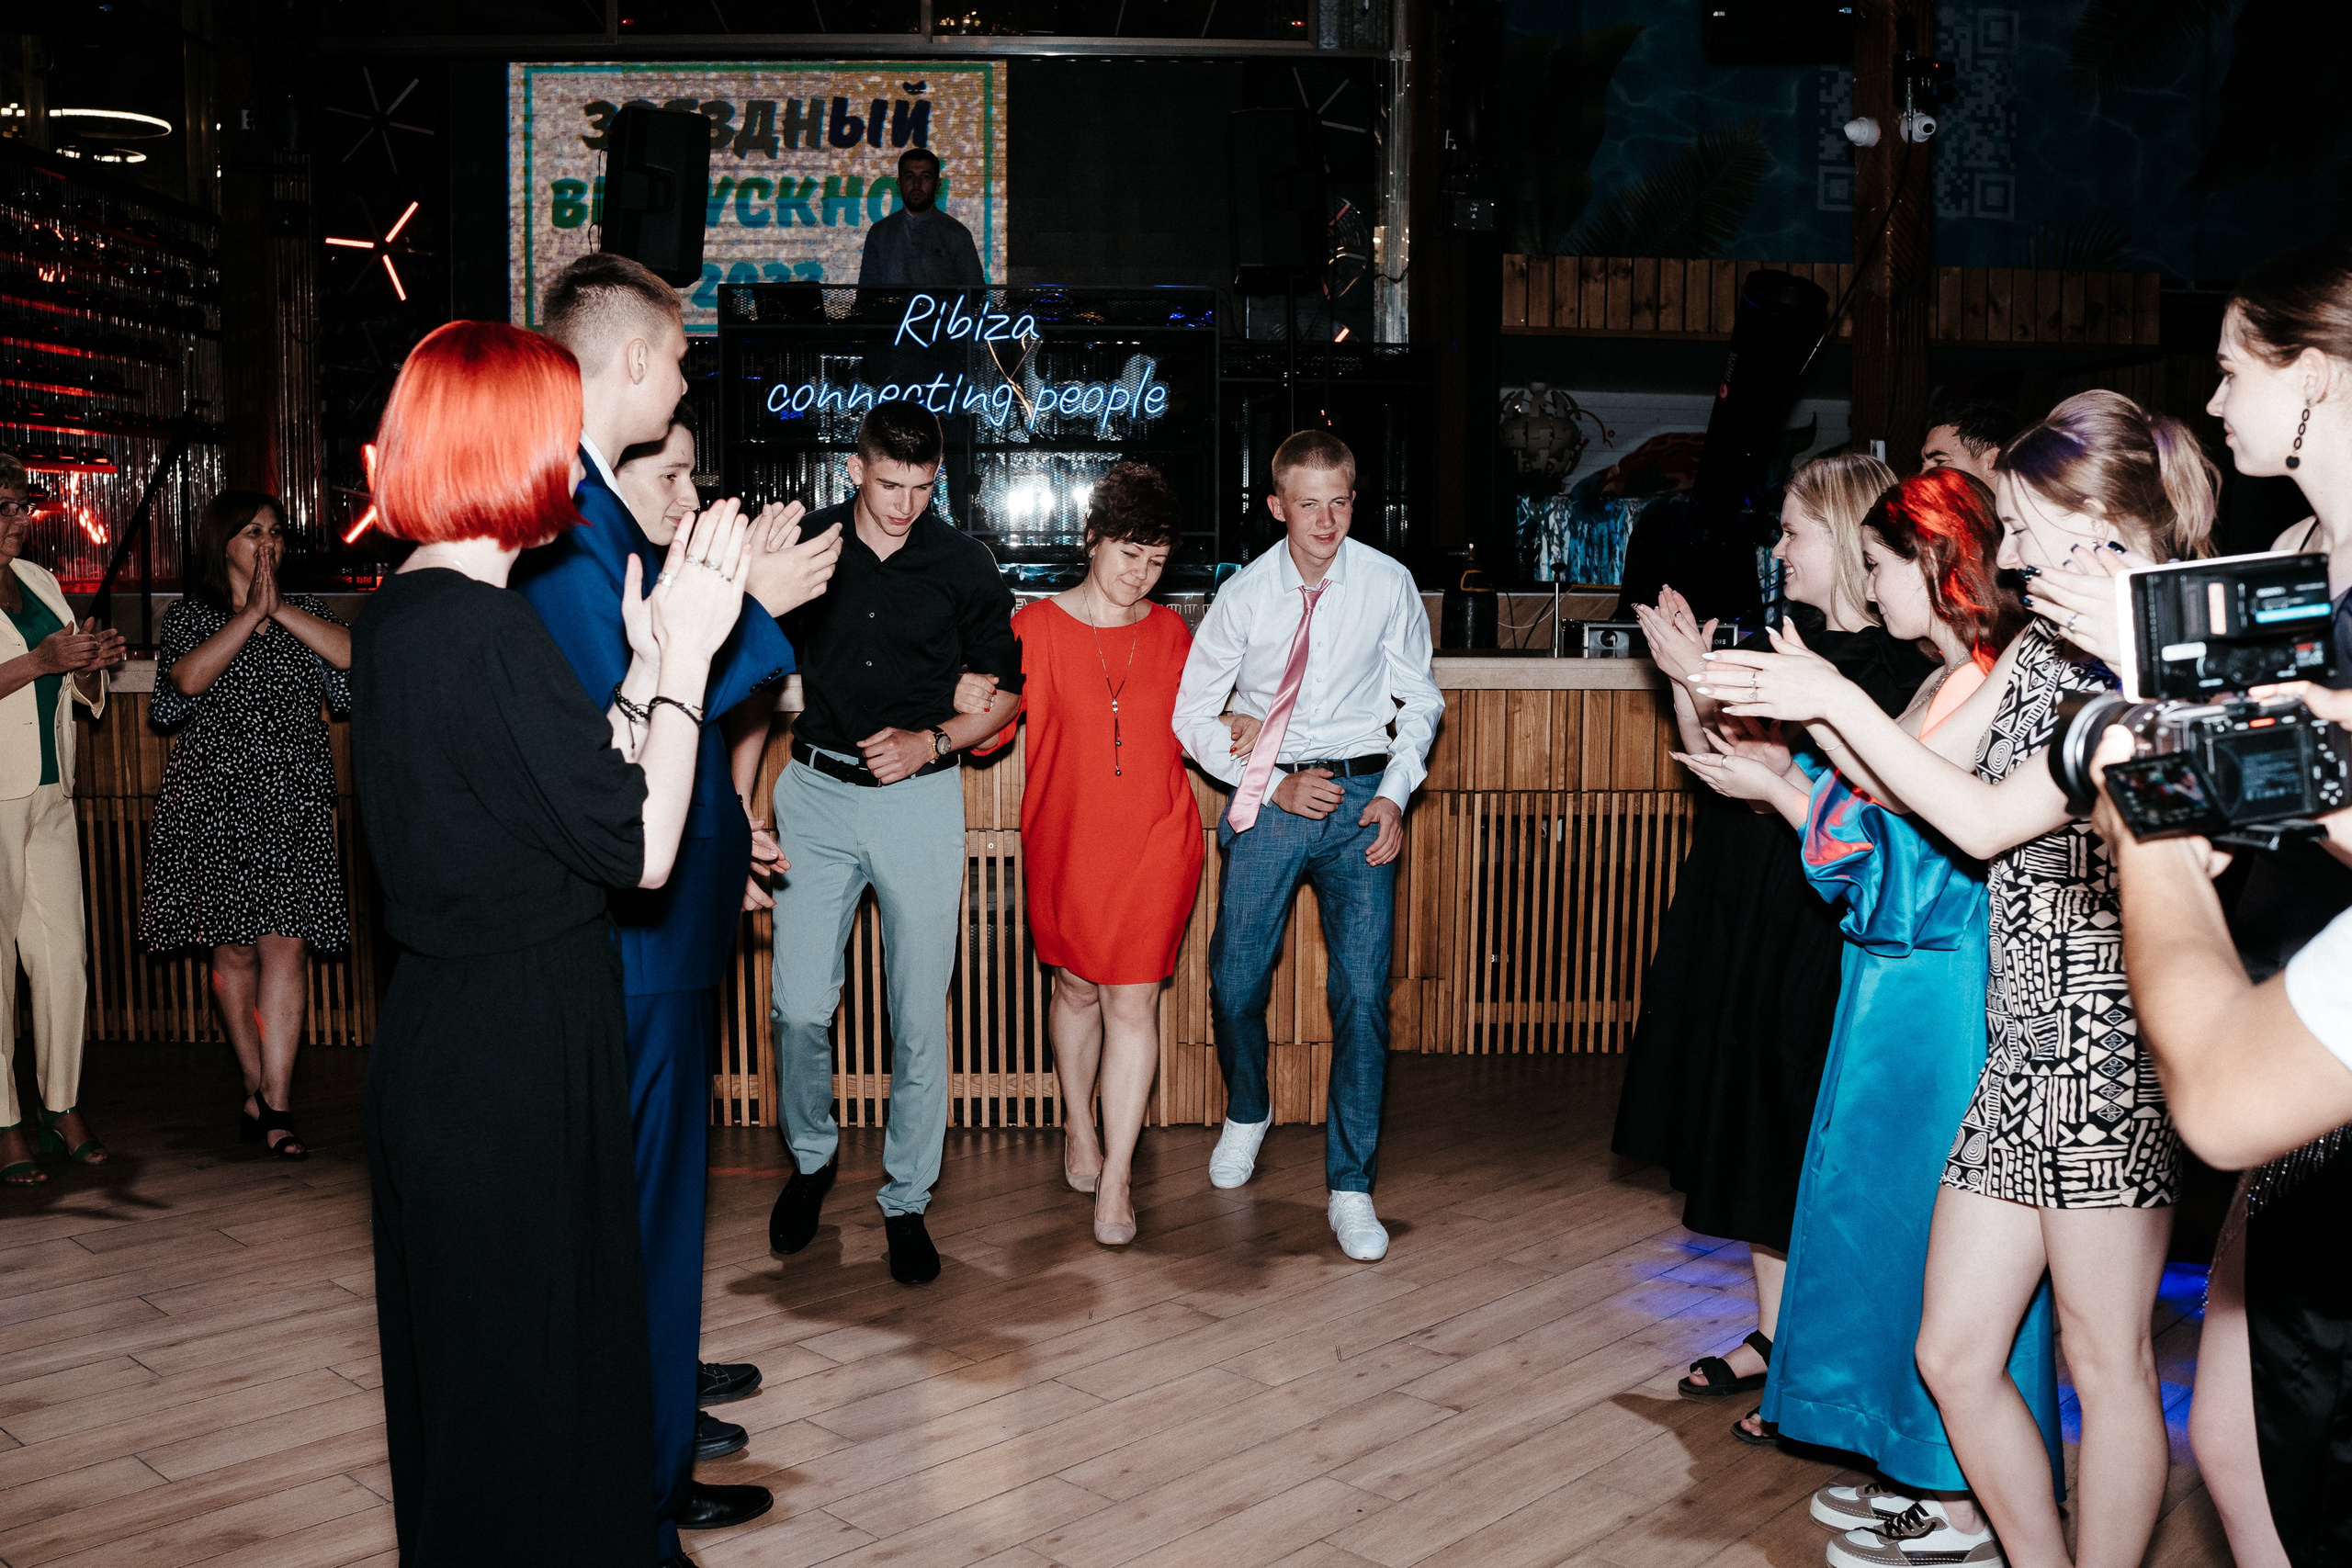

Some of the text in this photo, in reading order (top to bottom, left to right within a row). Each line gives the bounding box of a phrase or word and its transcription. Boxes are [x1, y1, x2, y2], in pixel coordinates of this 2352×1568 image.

[581, 81, 933, 160] ЗЗДНЫЙ
[893, 293, 1041, 348] Ribiza
[766, 364, 1167, 430] connecting people
